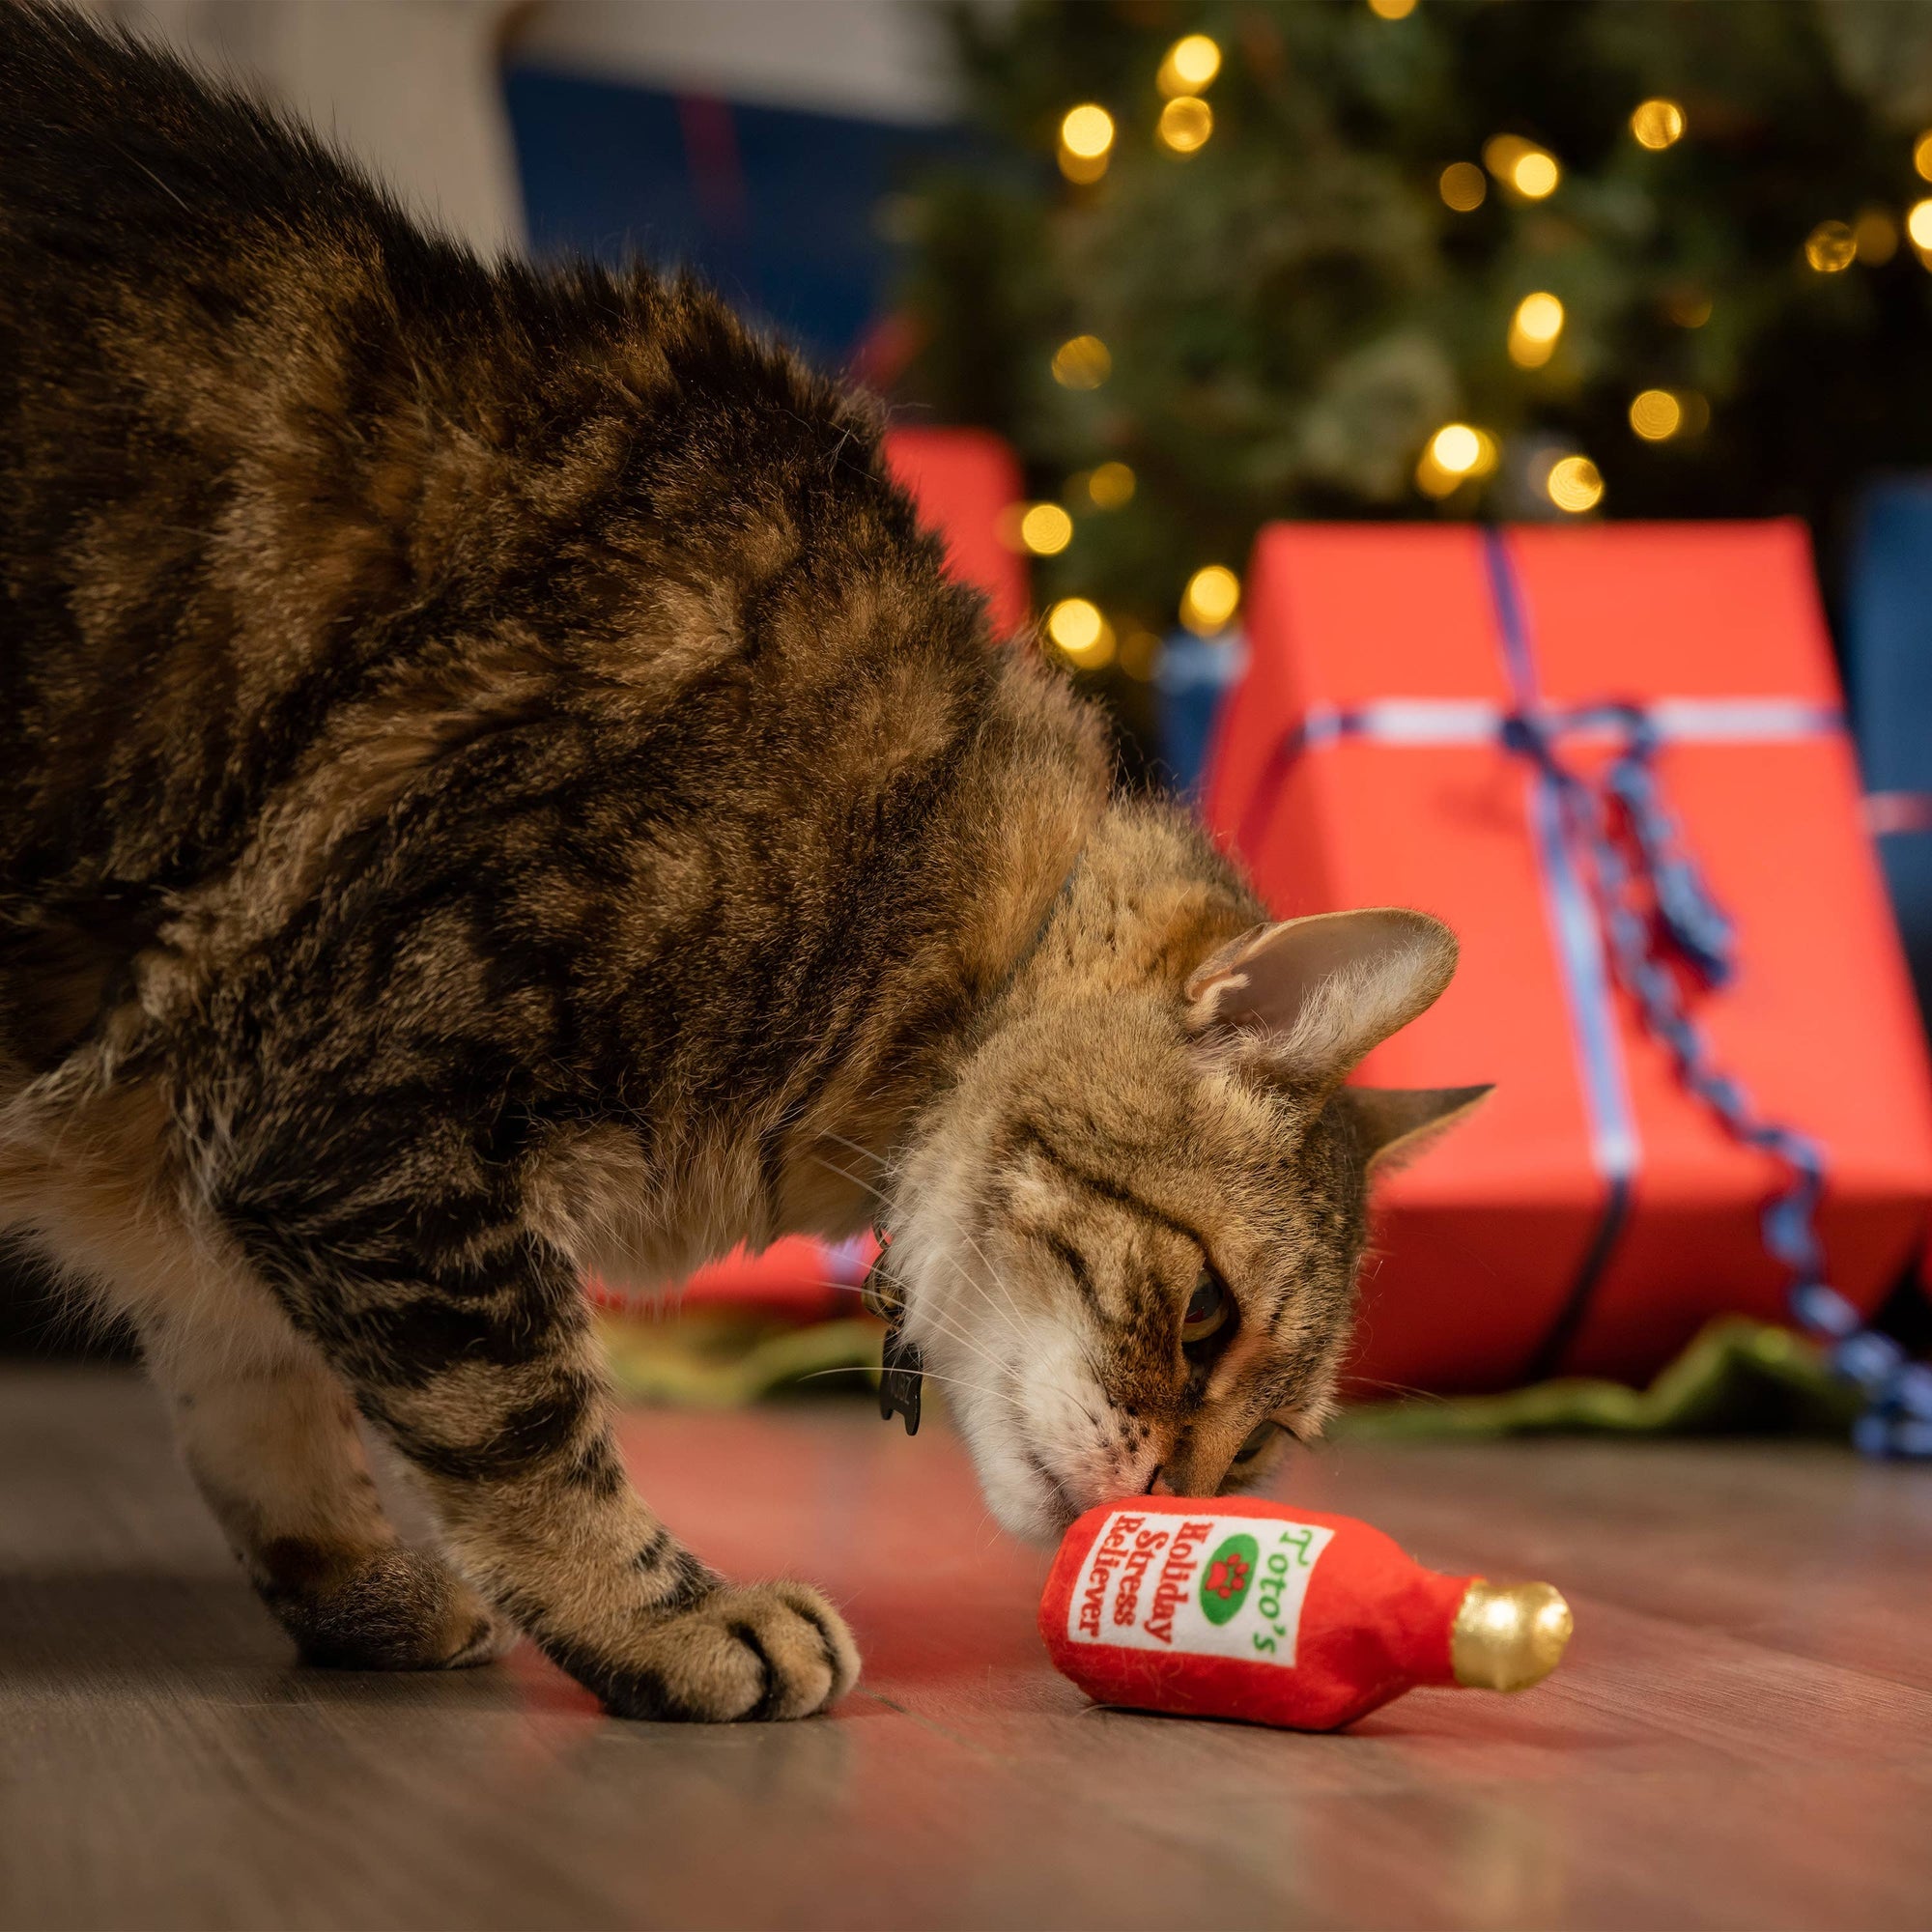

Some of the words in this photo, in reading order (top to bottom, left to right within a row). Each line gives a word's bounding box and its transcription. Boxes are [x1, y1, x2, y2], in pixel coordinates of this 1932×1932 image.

[1078, 1515, 1147, 1638] Reliever
[1113, 1529, 1170, 1628] Stress
[1144, 1521, 1214, 1644] Holiday
[1252, 1528, 1313, 1655] Toto's
